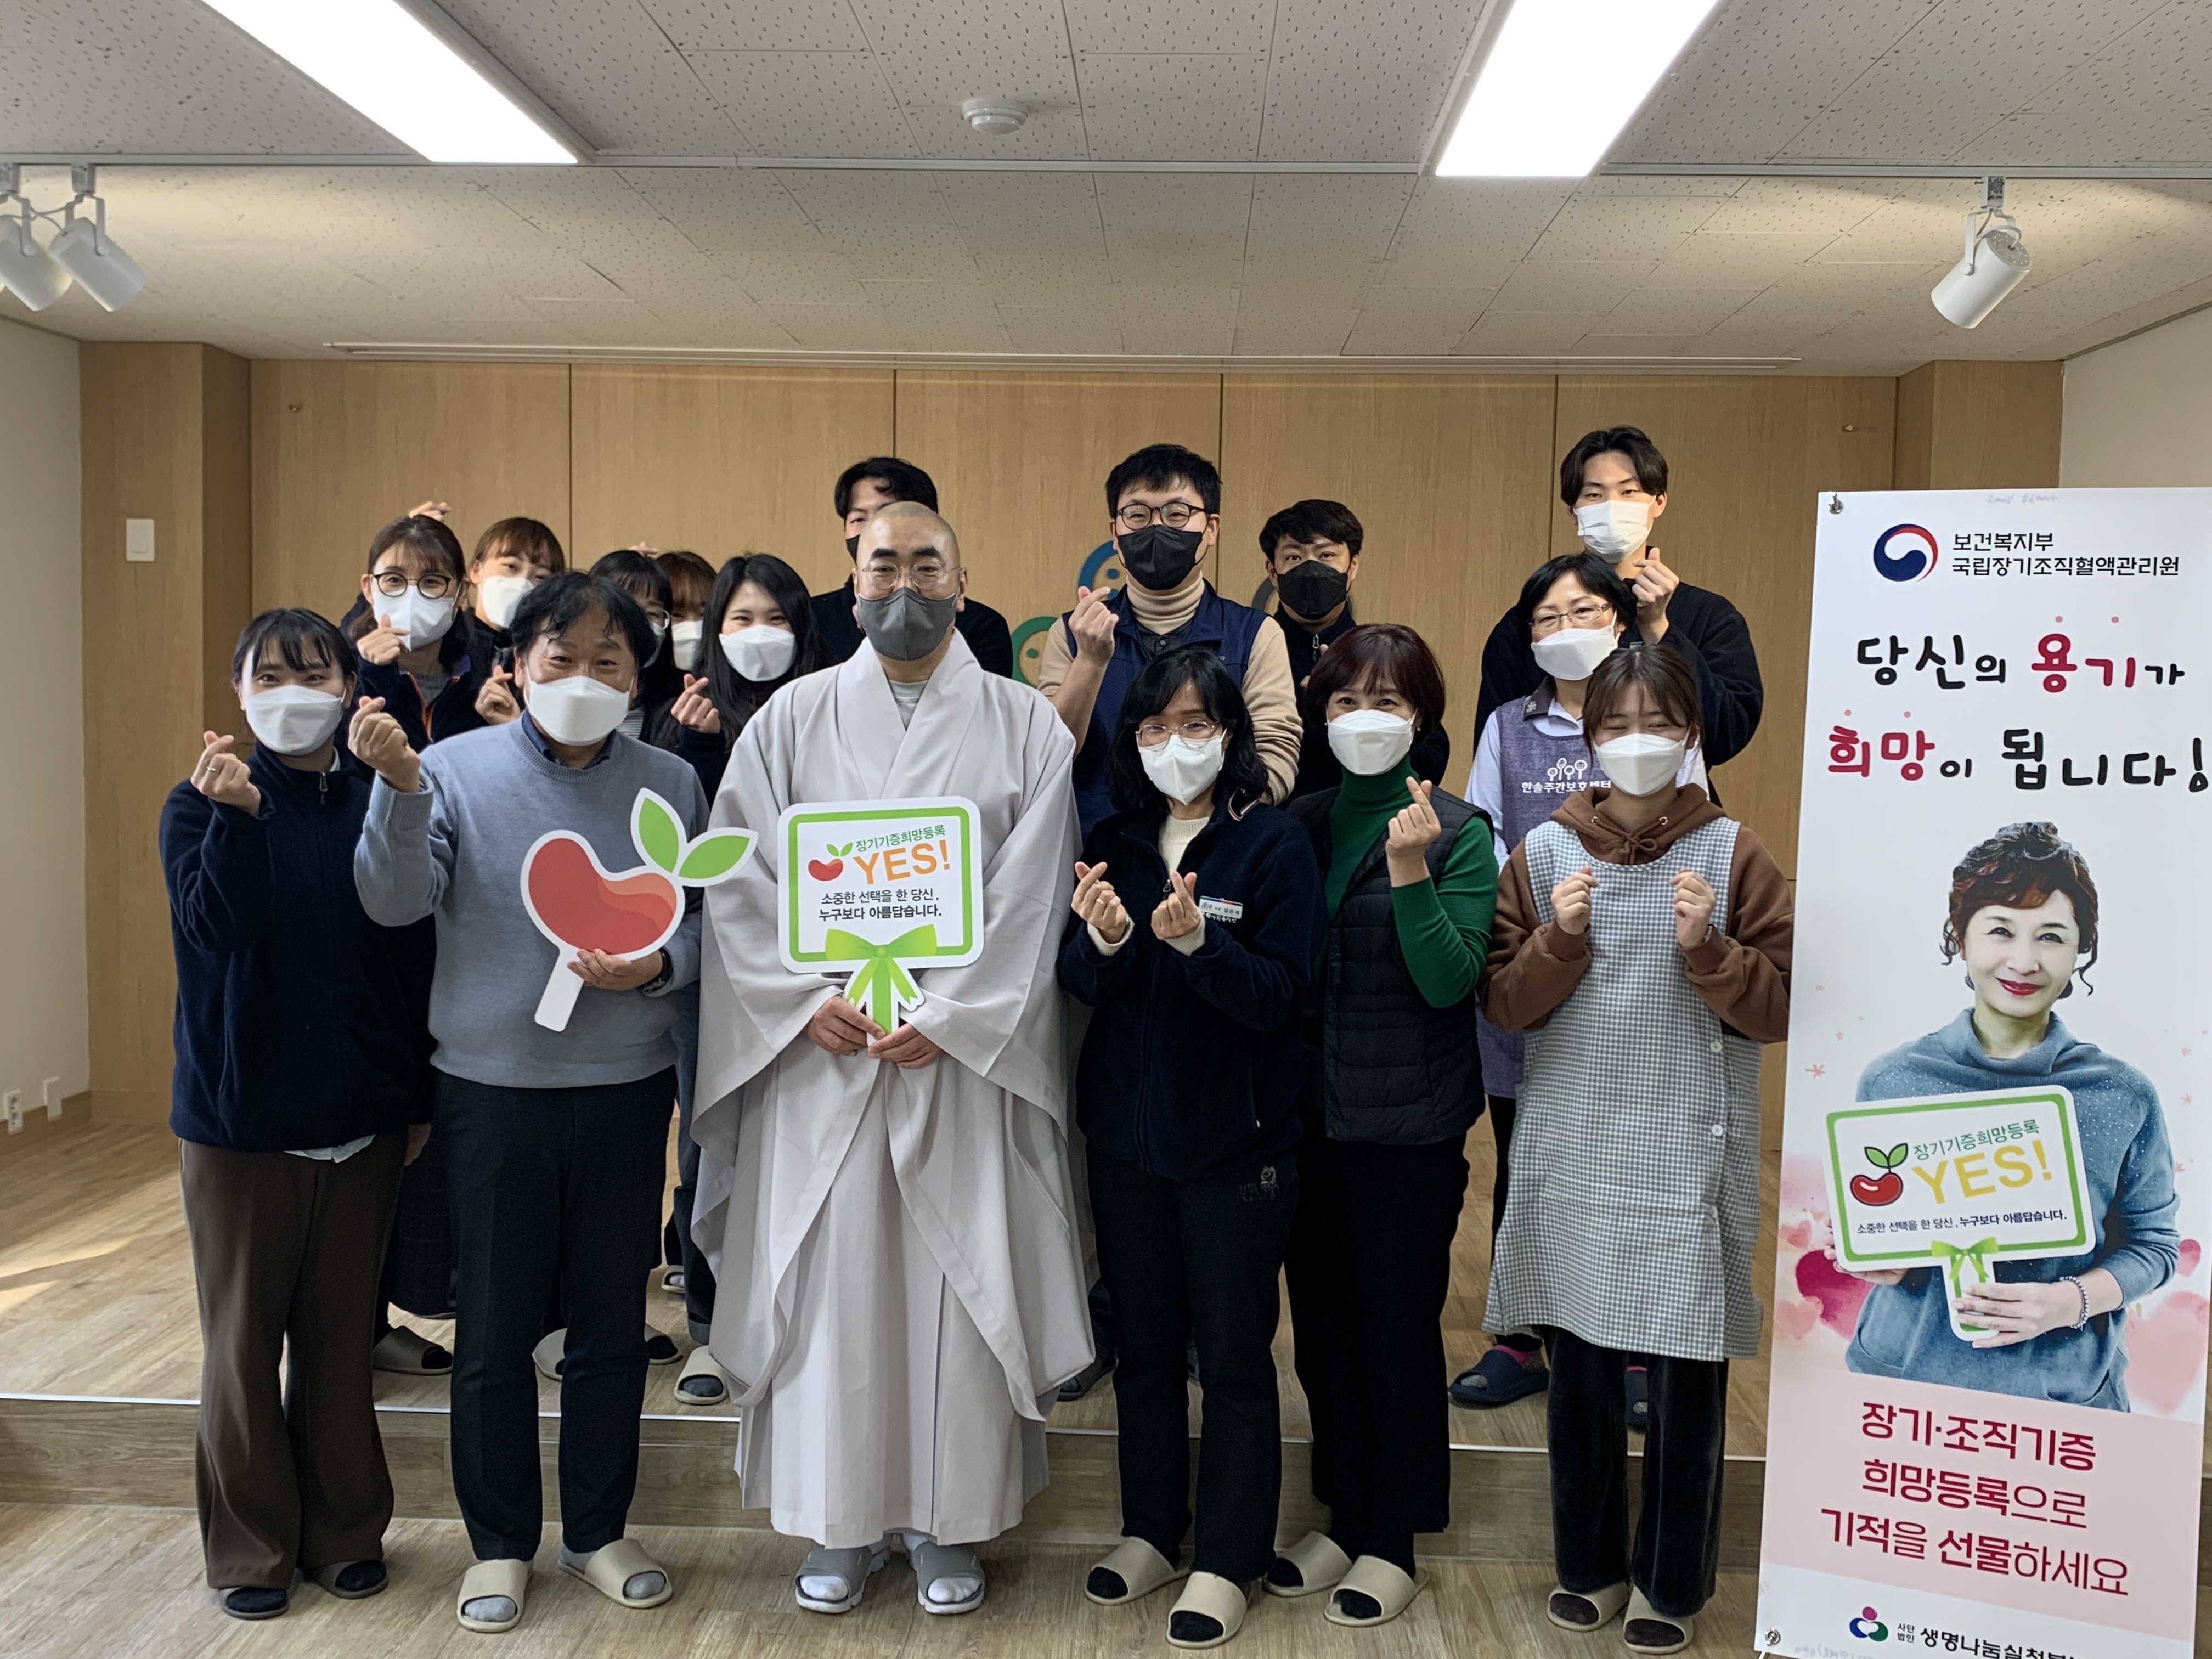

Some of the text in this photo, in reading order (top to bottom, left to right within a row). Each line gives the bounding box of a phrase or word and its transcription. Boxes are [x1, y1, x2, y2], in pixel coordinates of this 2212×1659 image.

[1953, 532, 2054, 552] 보건복지부
[1952, 556, 2179, 577] 국립장기조직혈액관리원
[1857, 633, 2186, 693] 당신의 용기가
[1827, 725, 2209, 793] 희망이 됩니다!
[855, 824, 946, 853] 장기기증희망등록
[853, 839, 950, 885] YES!
[821, 892, 855, 905] 소중한
[859, 889, 892, 904] 선택을
[896, 888, 907, 901] 한
[819, 904, 941, 922] 누구보다 아름답습니다.
[1914, 1119, 2040, 1161] 장기기증희망등록
[1911, 1139, 2052, 1205] YES!
[1857, 1222, 1886, 1234] 소중한
[1889, 1220, 1918, 1233] 선택을
[1921, 1219, 1931, 1230] 한
[1959, 1215, 2000, 1228] 누구보다
[2003, 1210, 2067, 1224] 아름답습니다.
[1862, 1458, 2087, 1529] 희망등록으로
[1821, 1508, 2129, 1596] 기적을 선물하세요
[1897, 1623, 1915, 1633] 사단
[1897, 1633, 1914, 1643] 법인
